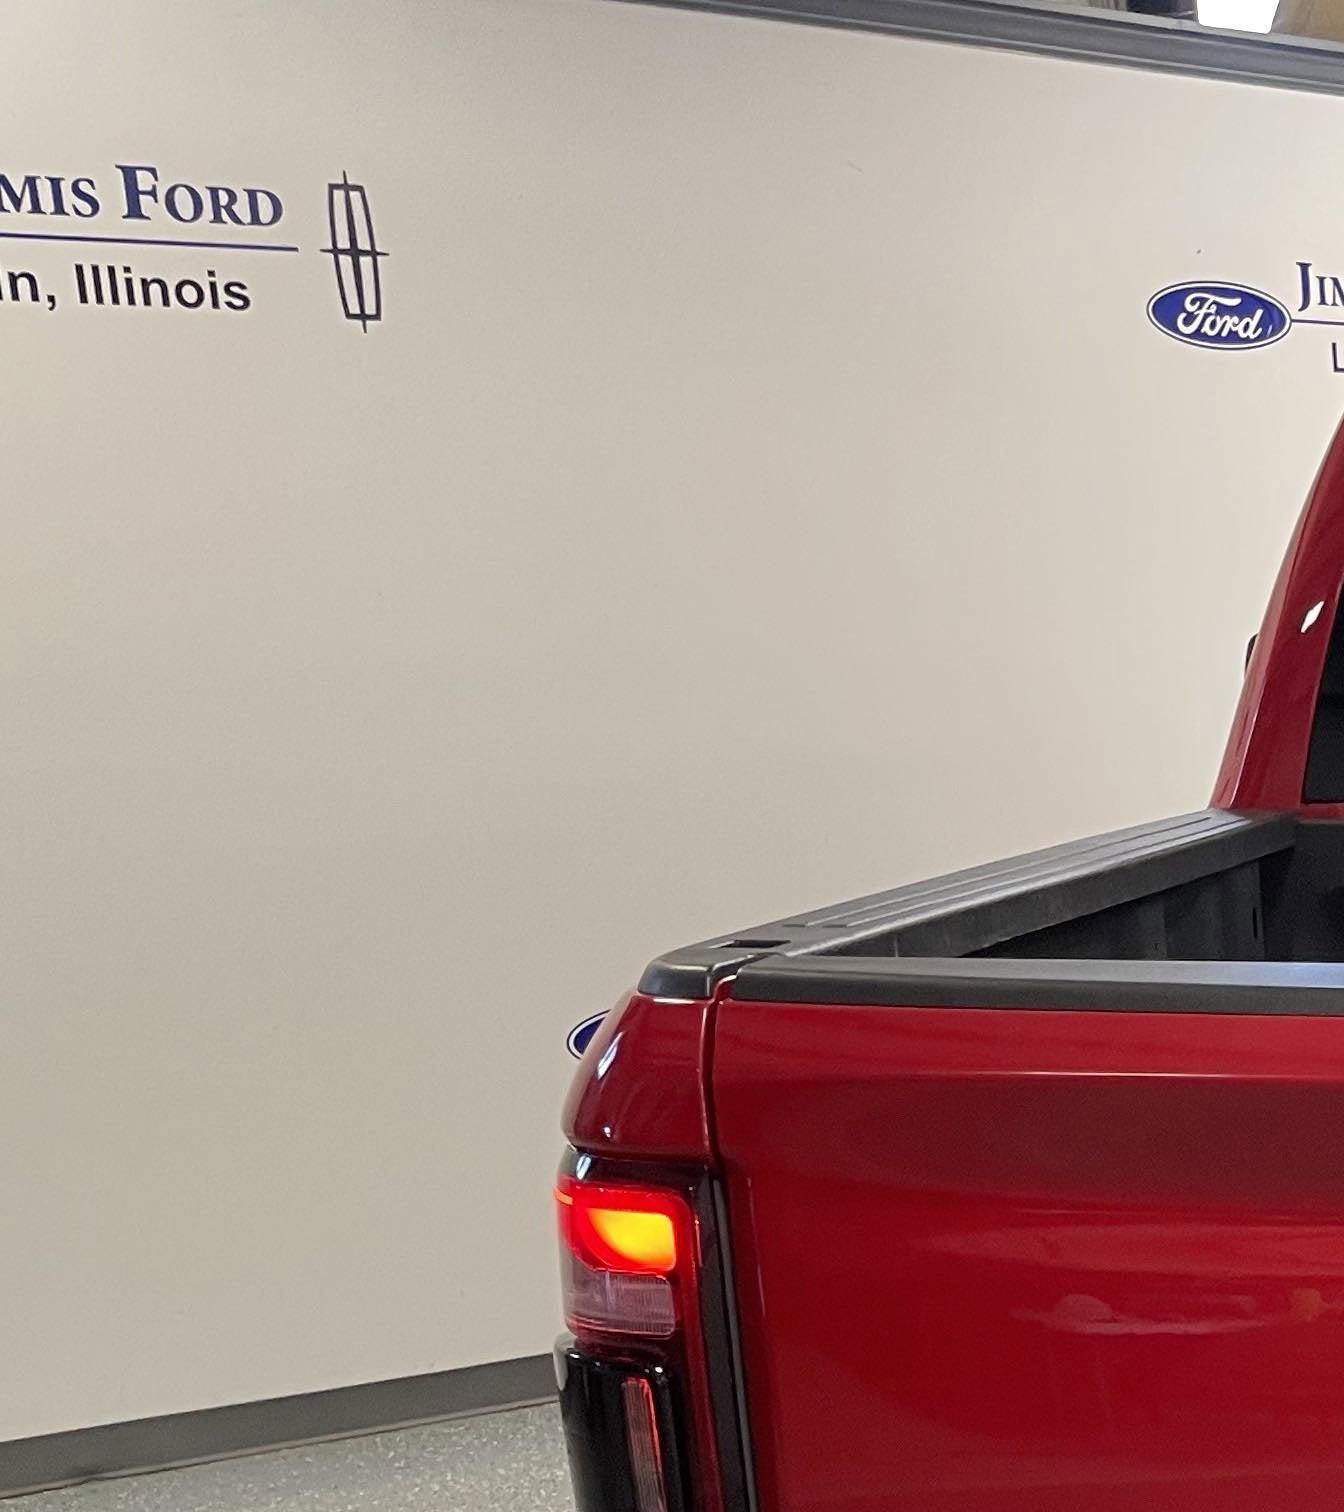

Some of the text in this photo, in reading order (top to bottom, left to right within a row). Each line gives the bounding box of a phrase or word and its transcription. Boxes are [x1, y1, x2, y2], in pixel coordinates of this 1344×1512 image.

[0, 164, 285, 226] MIS FORD
[73, 263, 252, 312] Illinois
[1176, 293, 1262, 338] Ford
